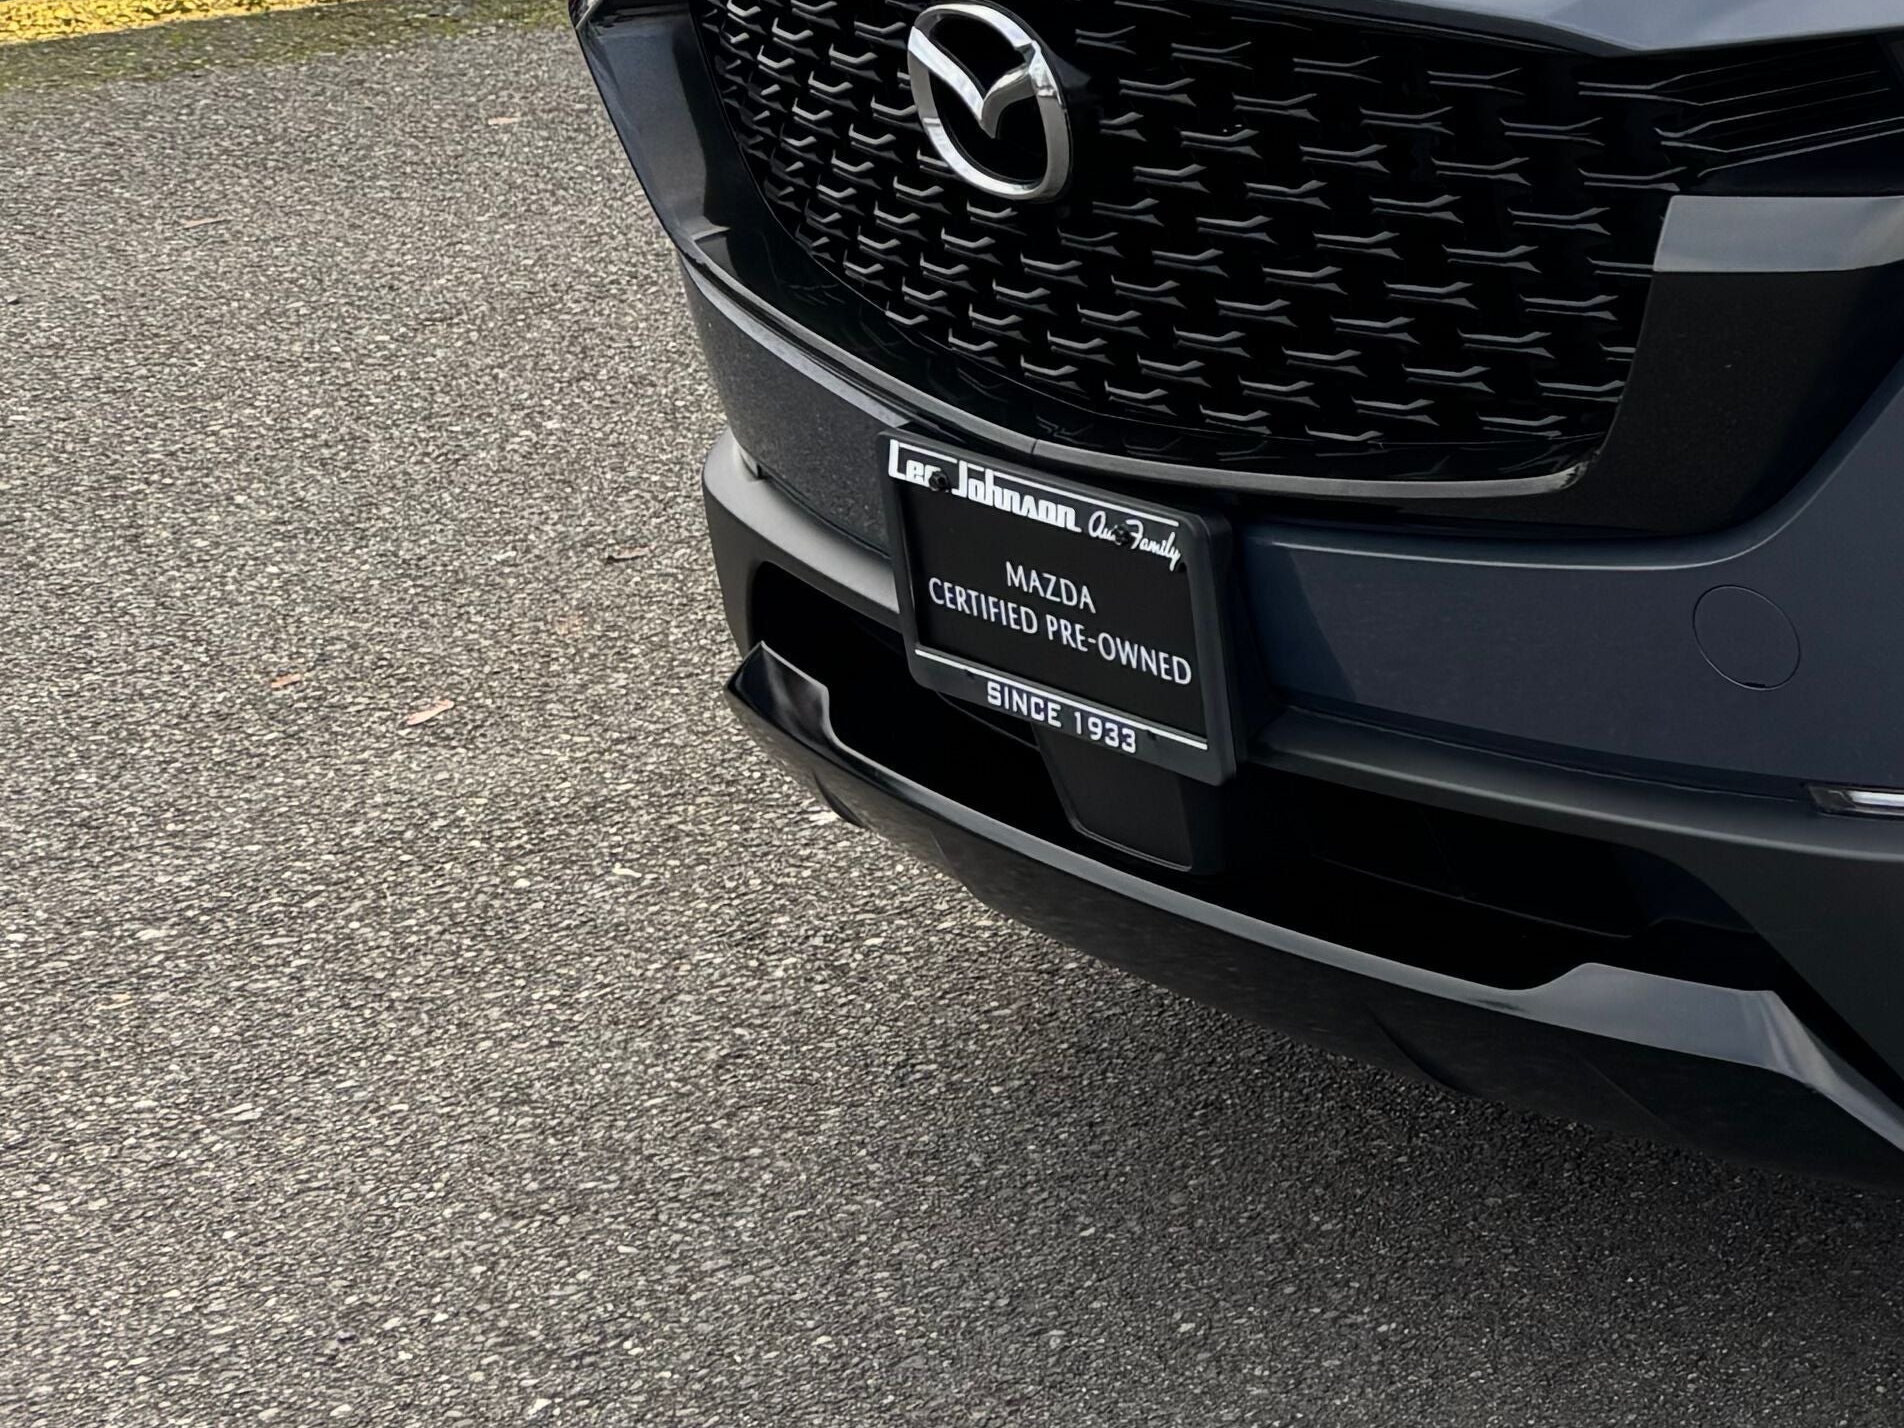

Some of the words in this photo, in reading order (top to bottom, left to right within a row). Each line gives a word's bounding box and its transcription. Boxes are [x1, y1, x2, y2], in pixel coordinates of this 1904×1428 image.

[952, 459, 1082, 533] Johnson
[1088, 510, 1130, 546] Au
[1126, 518, 1182, 572] Family
[928, 577, 1038, 635] CERTIFIED
[1045, 613, 1192, 686] PRE-OWNED
[1005, 560, 1096, 614] MAZDA
[987, 680, 1062, 728] SINCE
[1072, 710, 1137, 754] 1933
